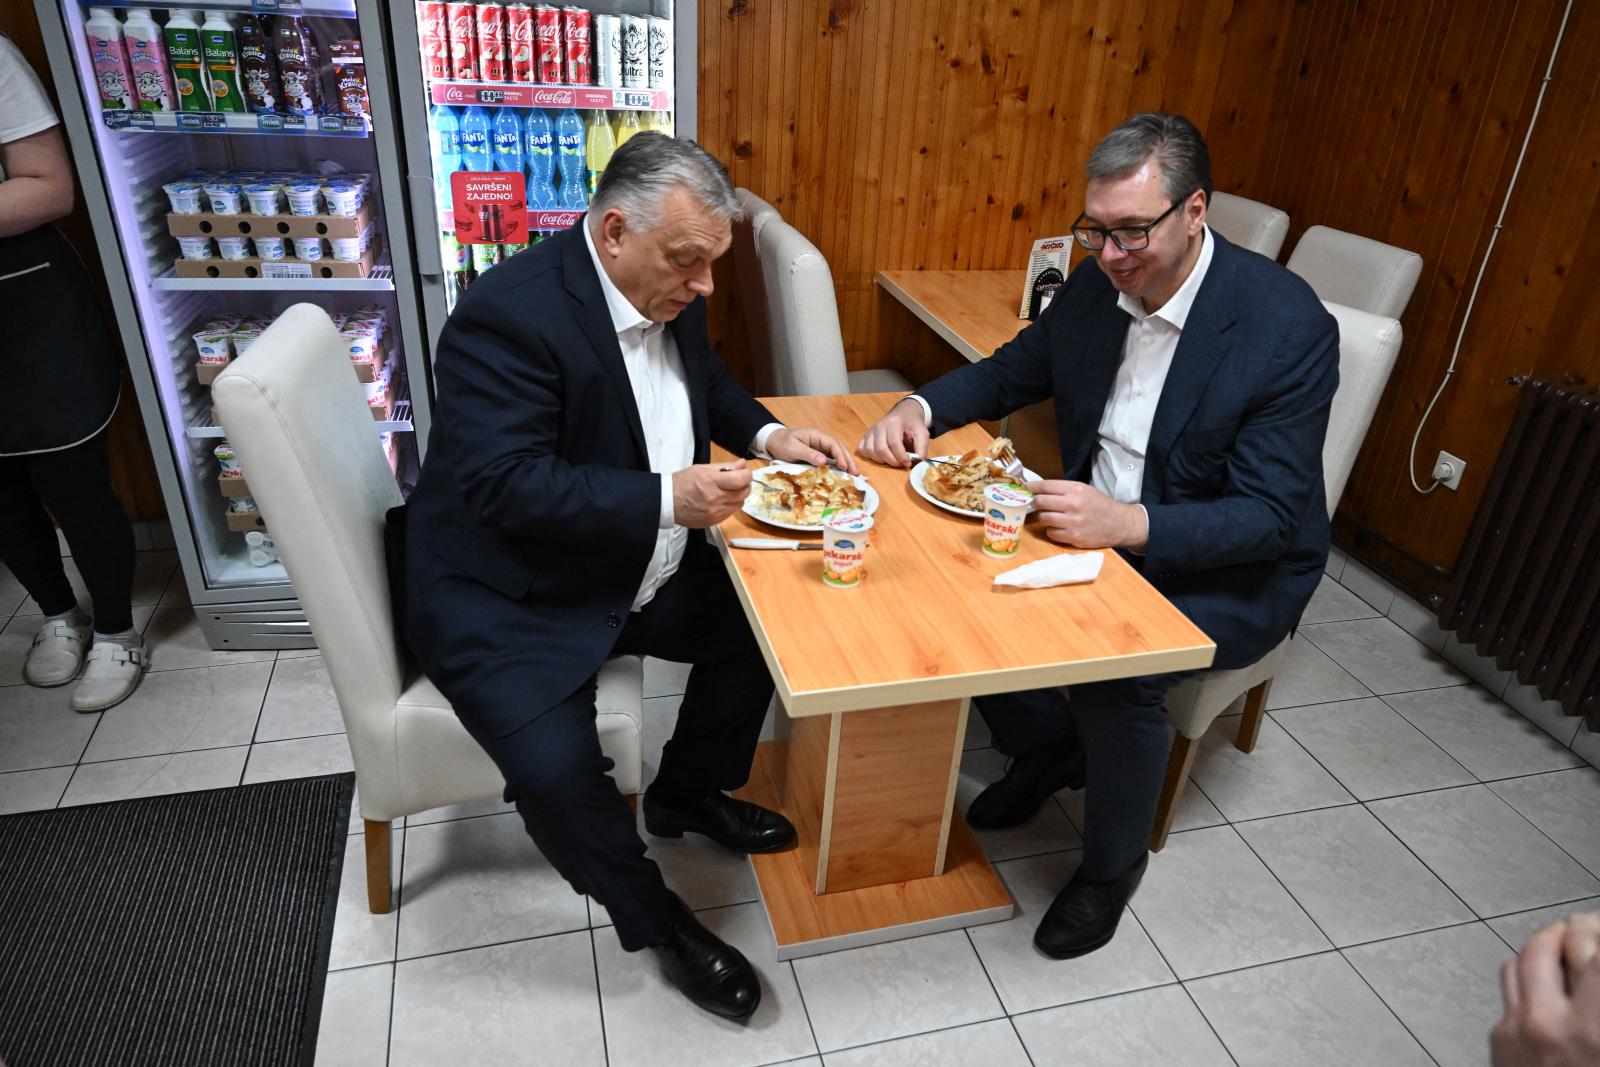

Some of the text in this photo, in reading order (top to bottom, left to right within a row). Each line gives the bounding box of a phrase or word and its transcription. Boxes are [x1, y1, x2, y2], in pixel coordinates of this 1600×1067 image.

[169, 46, 199, 56] Balans
[205, 47, 235, 57] Balans
[534, 90, 573, 104] Coca-Cola
[461, 132, 486, 142] FANTA
[494, 133, 516, 143] FANTA
[466, 182, 512, 191] SAVRŠENI
[466, 192, 513, 200] ZAJEDNO!
[540, 213, 576, 225] Coca-Cola
